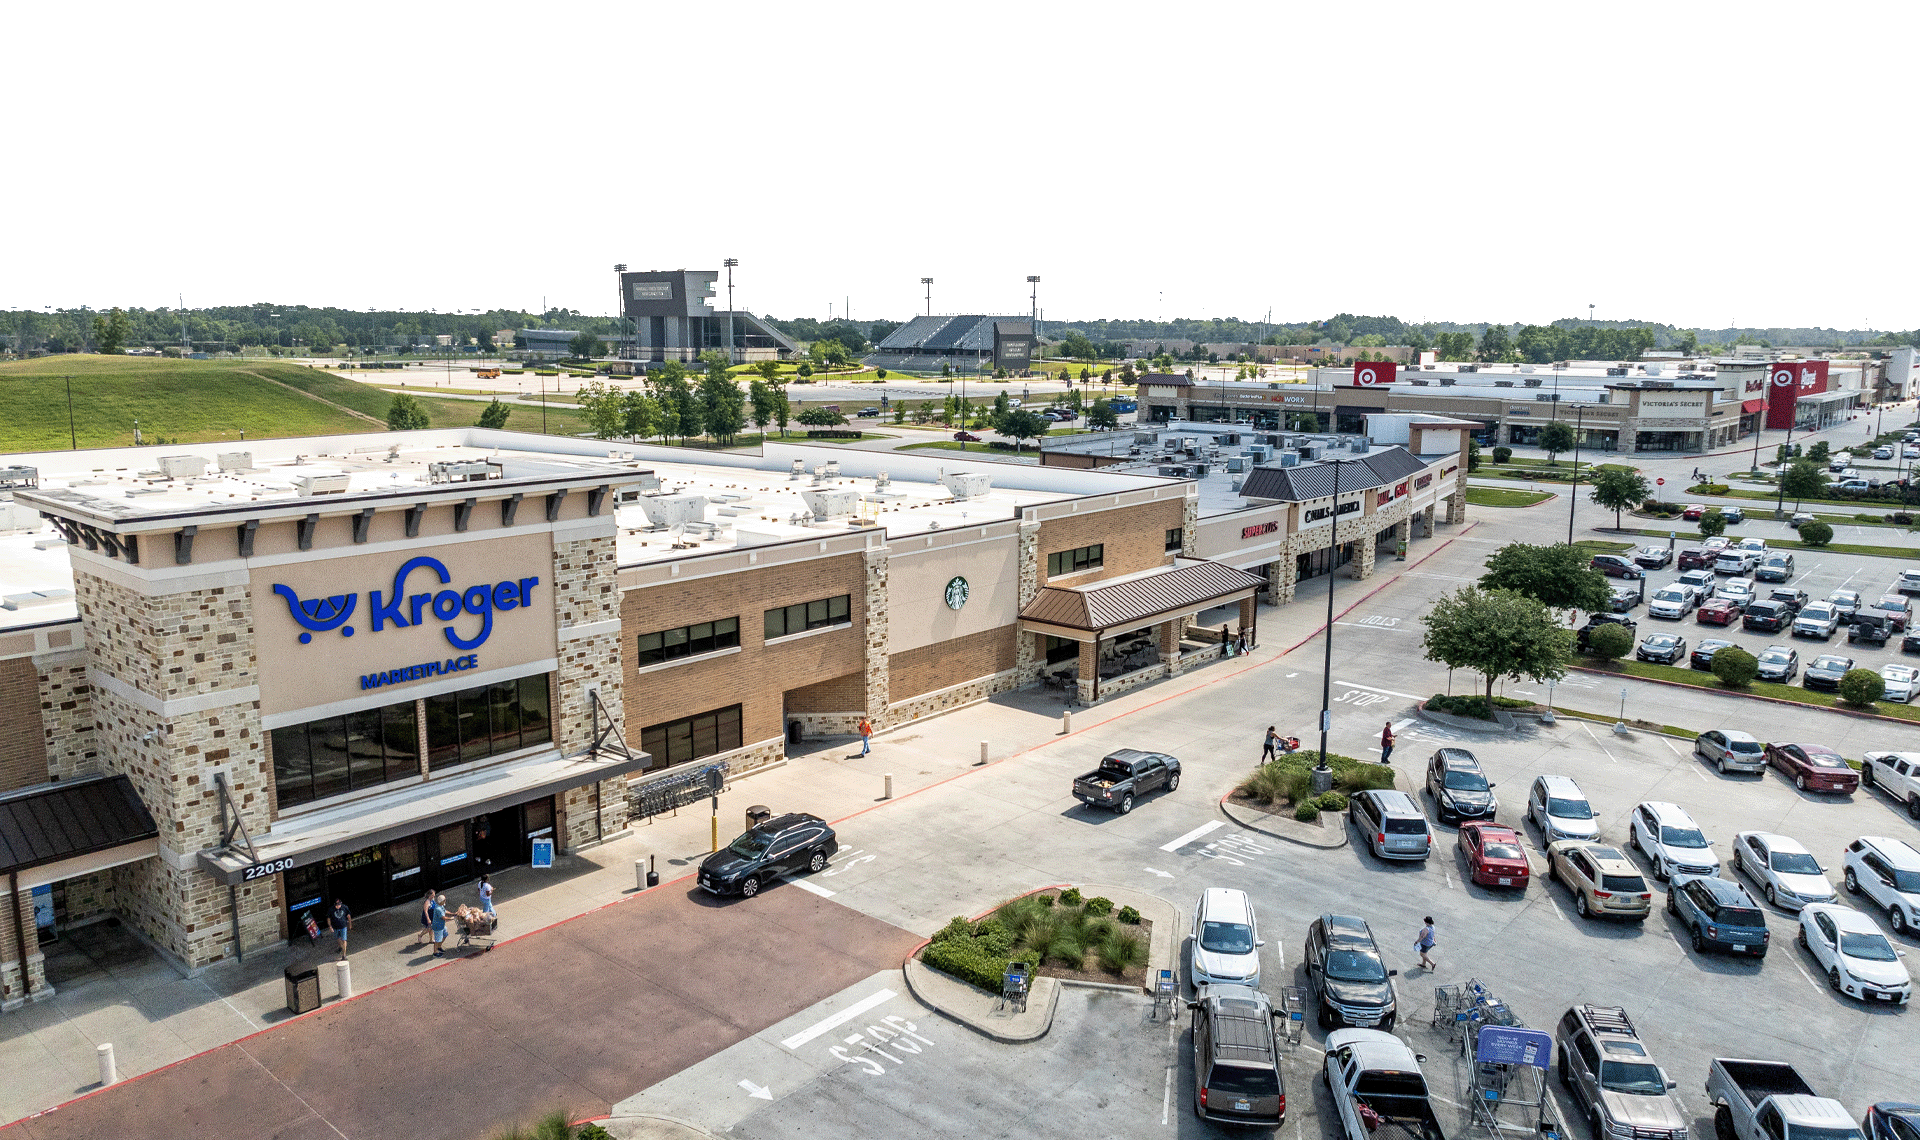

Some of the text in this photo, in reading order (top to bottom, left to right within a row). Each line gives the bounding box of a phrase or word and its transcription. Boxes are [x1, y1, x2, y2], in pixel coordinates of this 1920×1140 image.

[1241, 521, 1279, 539] SUPERCUTS
[369, 556, 539, 650] Kroger
[361, 654, 479, 690] MARKETPLACE
[1333, 690, 1390, 707] STOP
[1197, 833, 1272, 867] STOP
[245, 858, 294, 880] 22030
[829, 1015, 935, 1076] STOP
